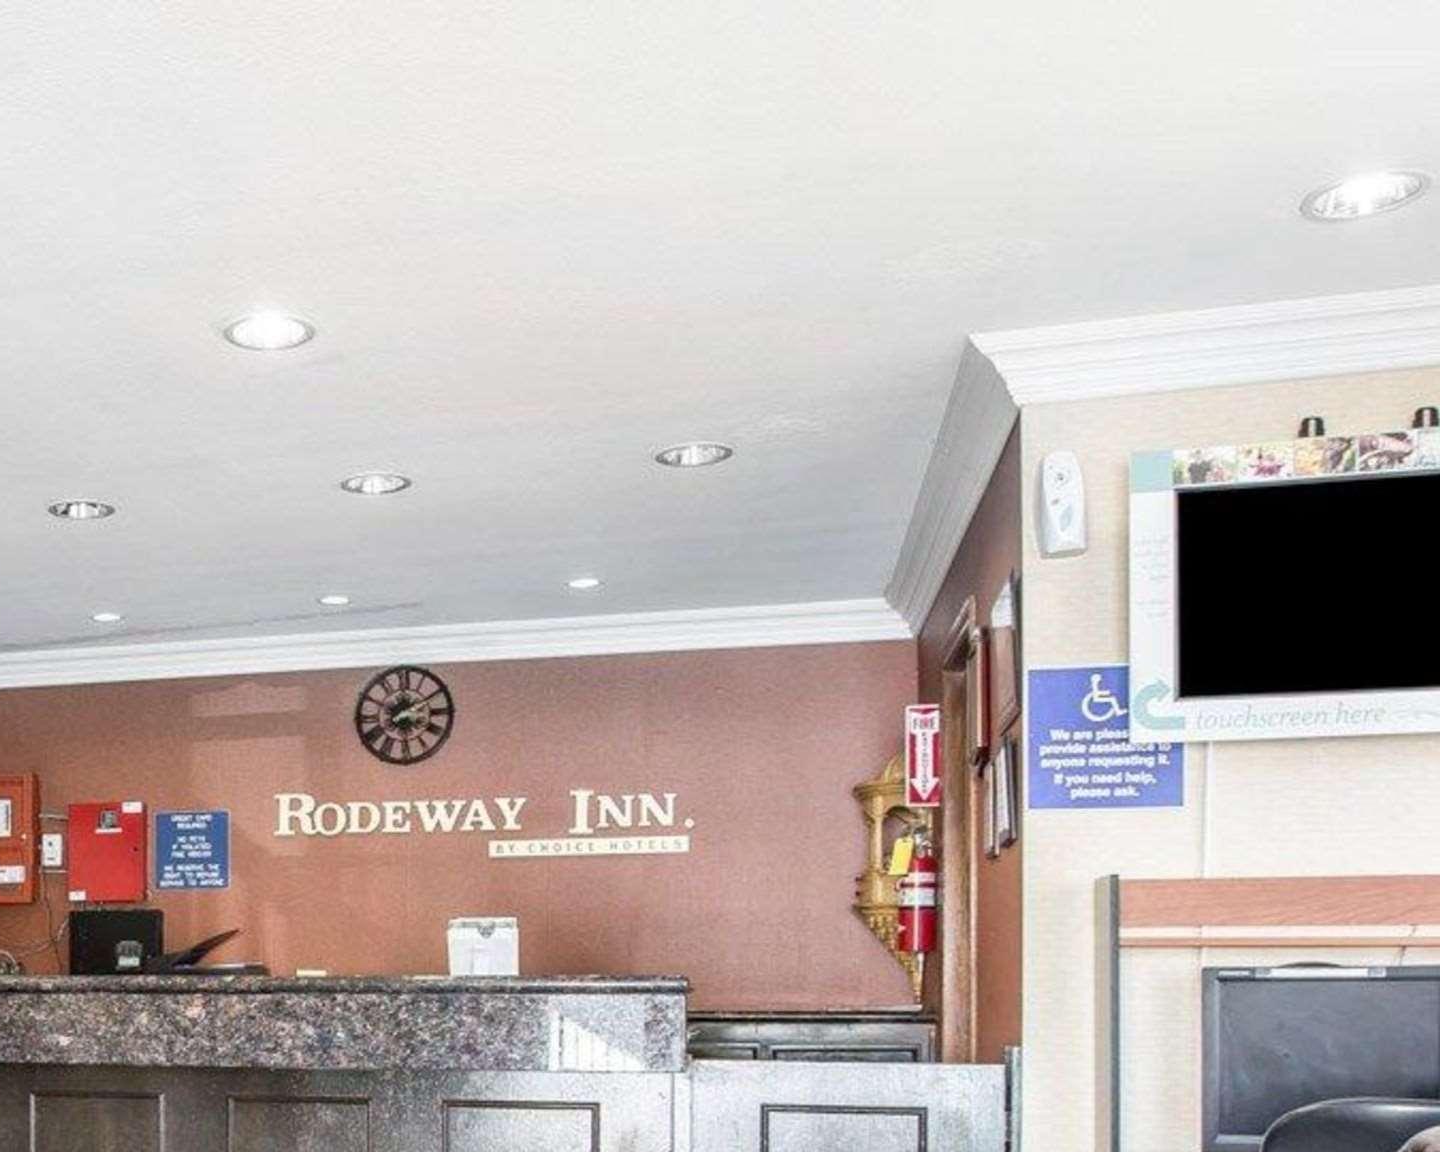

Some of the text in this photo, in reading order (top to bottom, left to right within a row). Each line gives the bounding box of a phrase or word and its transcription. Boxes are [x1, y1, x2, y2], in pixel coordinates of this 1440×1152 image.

[1197, 701, 1387, 730] touchscreen here
[1050, 729, 1070, 741] We
[1073, 731, 1093, 741] are
[1040, 744, 1087, 756] provide
[1040, 758, 1086, 770] anyone
[1088, 755, 1155, 768] requesting
[1065, 775, 1089, 787] you
[1091, 772, 1122, 784] need
[1070, 787, 1111, 800] please
[273, 793, 527, 837] RODEWAY
[495, 839, 683, 854] BY CHOICE HOTELS
